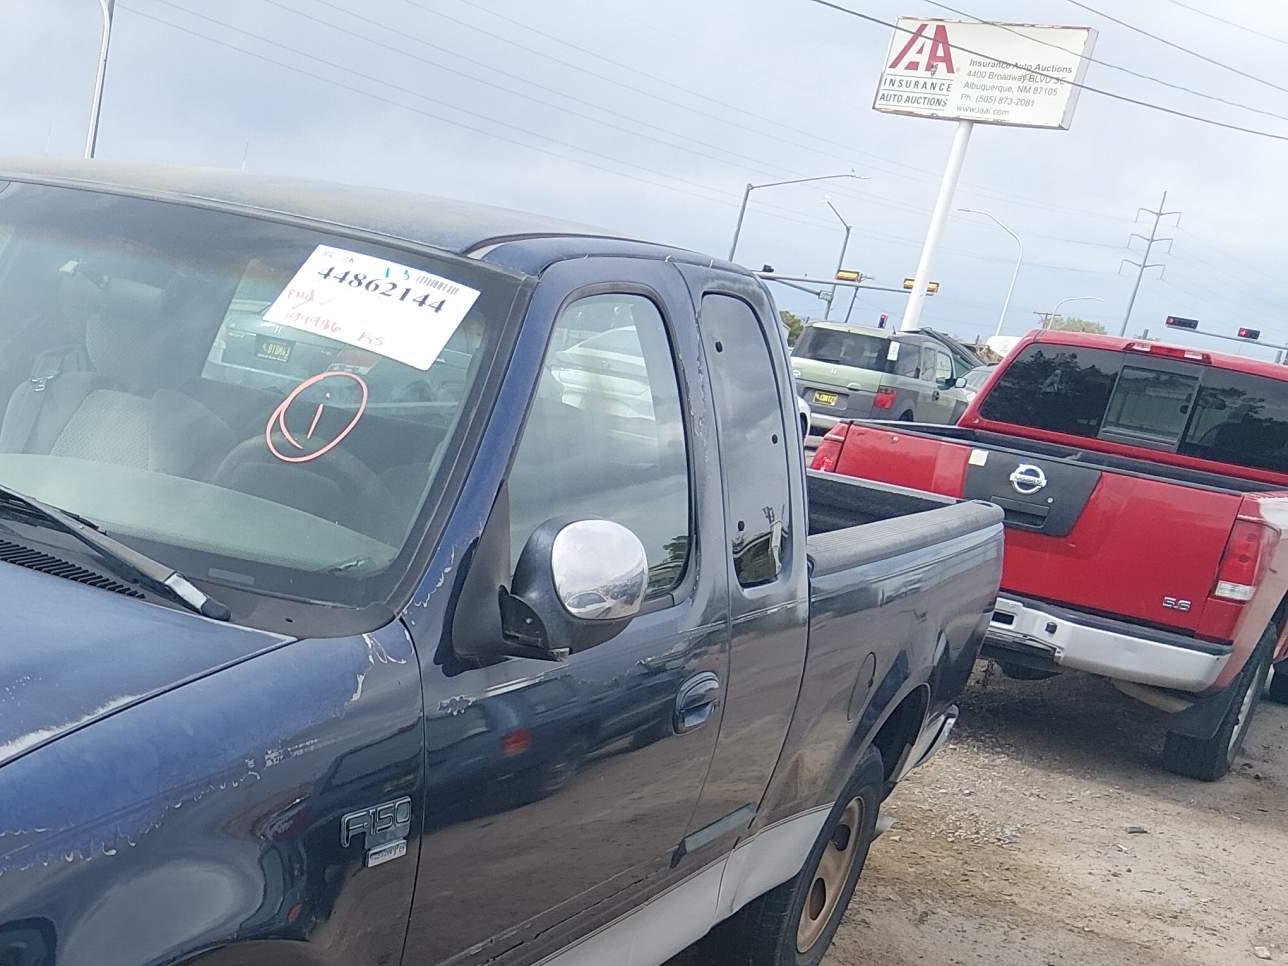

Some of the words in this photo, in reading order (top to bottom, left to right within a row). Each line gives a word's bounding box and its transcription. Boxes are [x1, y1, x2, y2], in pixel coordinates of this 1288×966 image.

[969, 58, 1014, 69] Insurance
[1013, 62, 1033, 71] Auto
[1034, 63, 1073, 74] Auctions
[883, 77, 953, 92] INSURANCE
[967, 70, 987, 79] 4400
[987, 71, 1027, 84] Broadway
[1028, 74, 1054, 84] BLVD
[963, 81, 1014, 93] Albuquerque,
[1016, 85, 1032, 94] NM
[1032, 87, 1058, 96] 87105
[879, 93, 904, 103] AUTO
[904, 95, 948, 107] AUCTIONS
[975, 94, 997, 105] (505)
[998, 96, 1035, 107] 873-2081
[317, 266, 447, 314] 44862144
